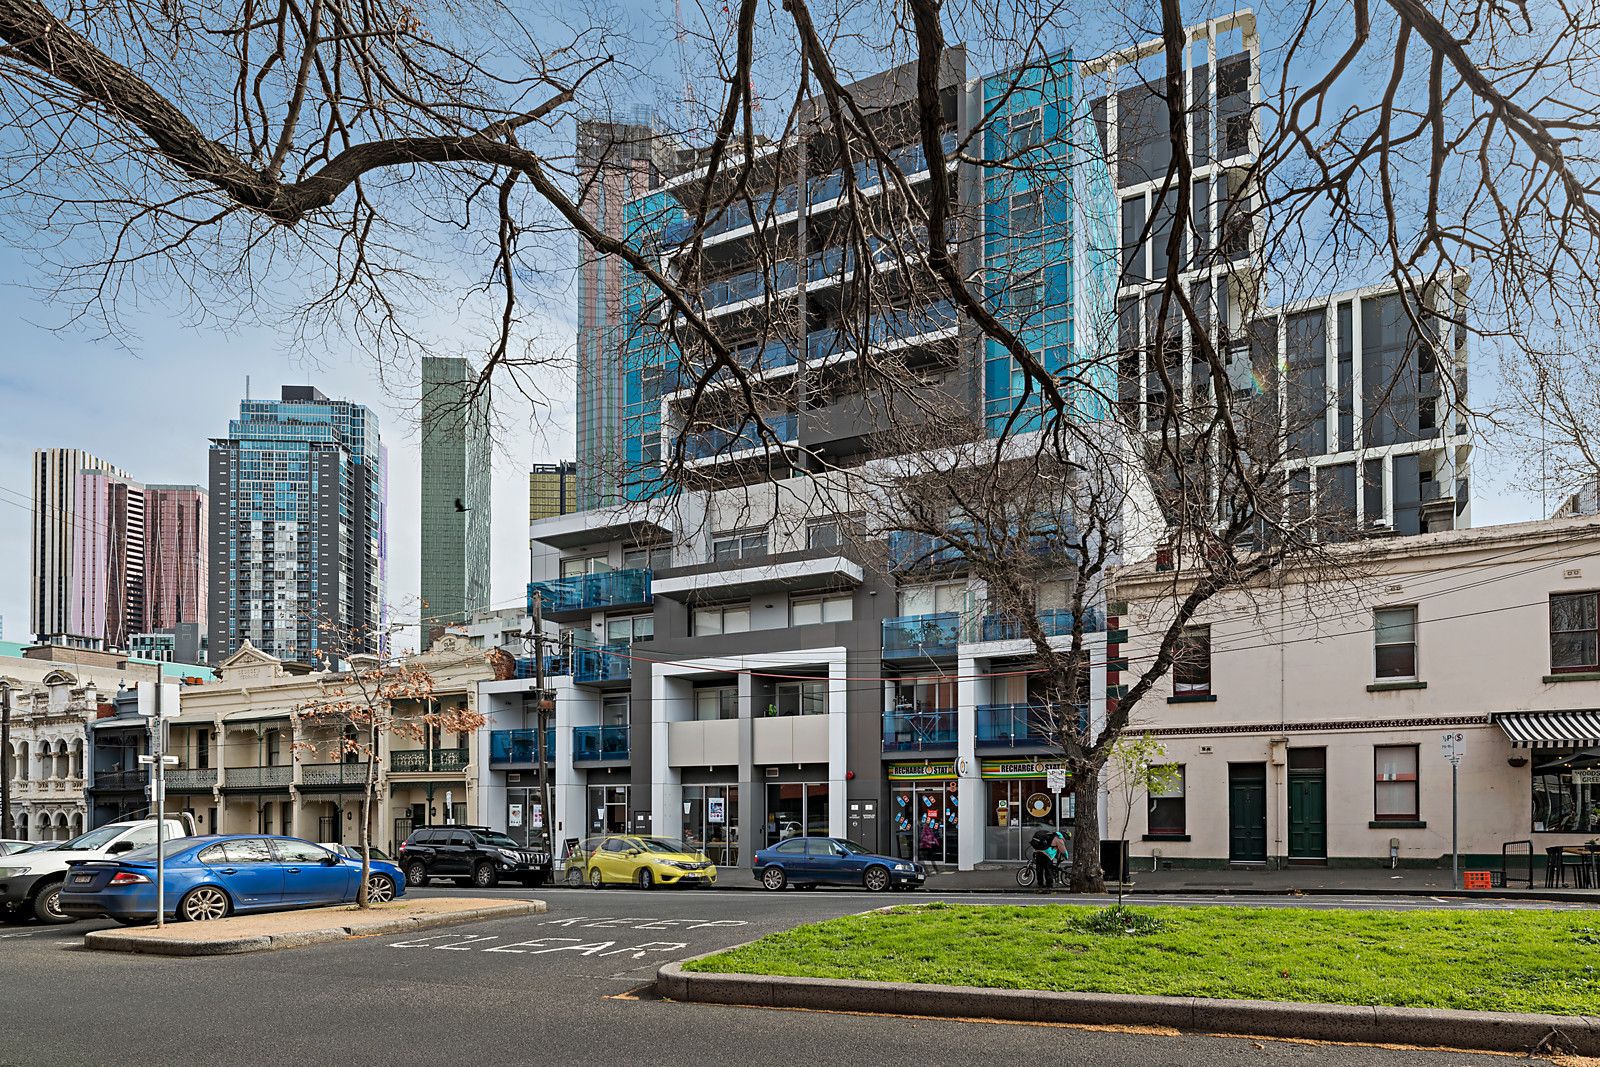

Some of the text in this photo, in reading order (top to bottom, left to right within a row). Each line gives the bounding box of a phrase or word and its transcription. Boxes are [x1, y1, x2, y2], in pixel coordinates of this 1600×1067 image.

[894, 766, 925, 775] RECHARGE
[1001, 763, 1035, 773] RECHARGE
[538, 916, 749, 930] KEEP
[385, 933, 690, 959] CLEAR
